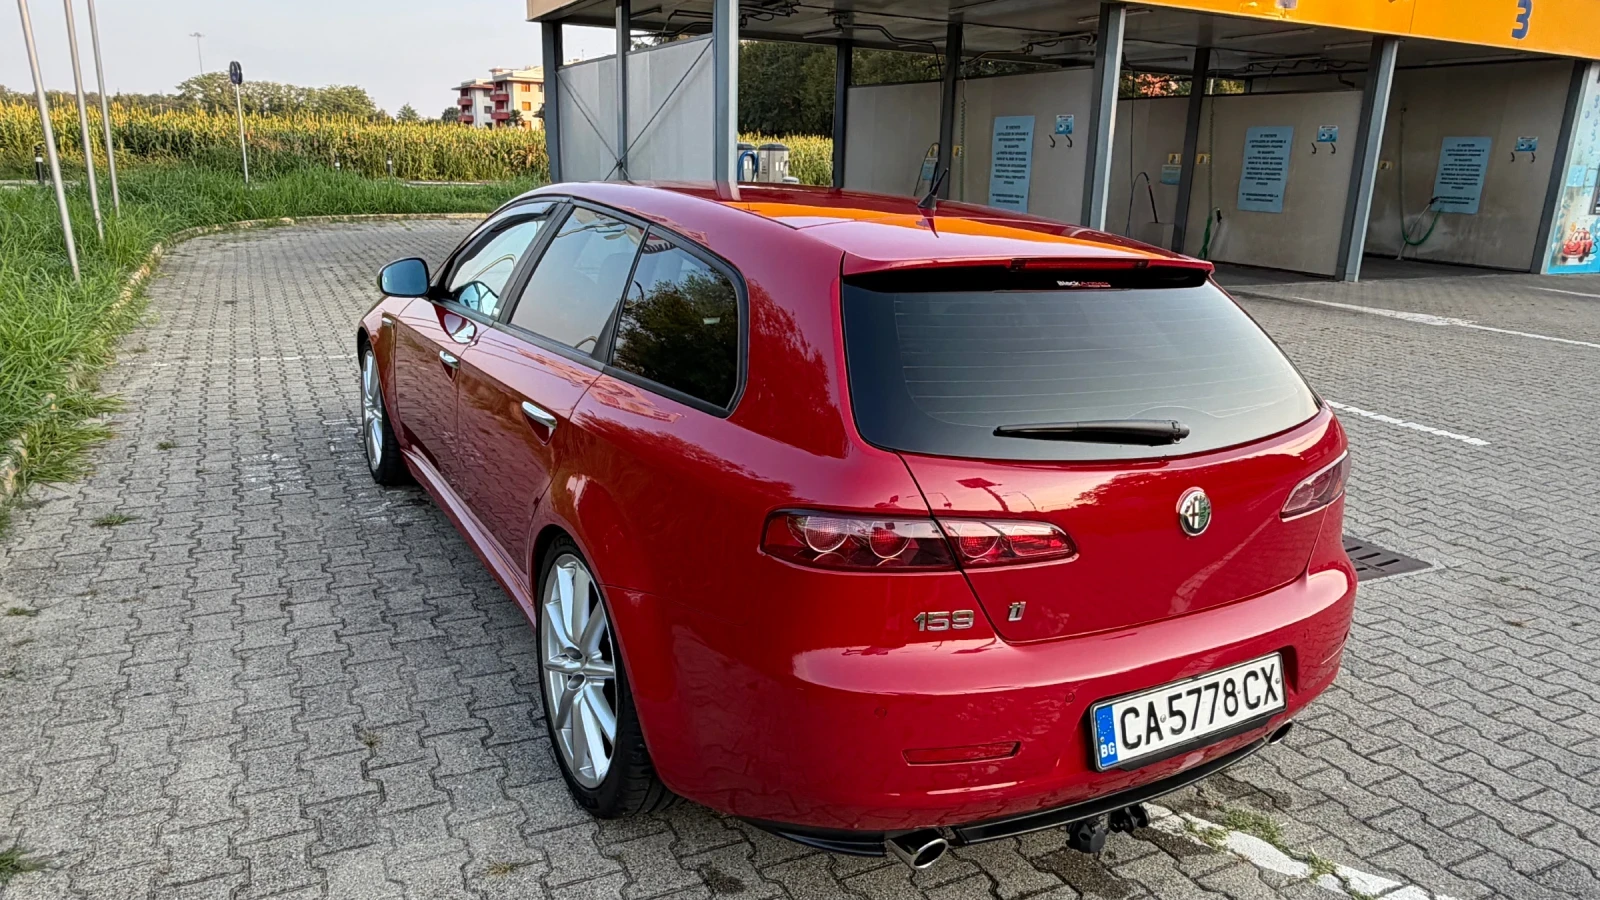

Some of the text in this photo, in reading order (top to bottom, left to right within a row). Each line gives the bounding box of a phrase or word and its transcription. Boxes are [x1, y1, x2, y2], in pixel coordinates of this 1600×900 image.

[1511, 0, 1533, 39] 3
[913, 609, 974, 631] 159
[1100, 742, 1116, 758] BG
